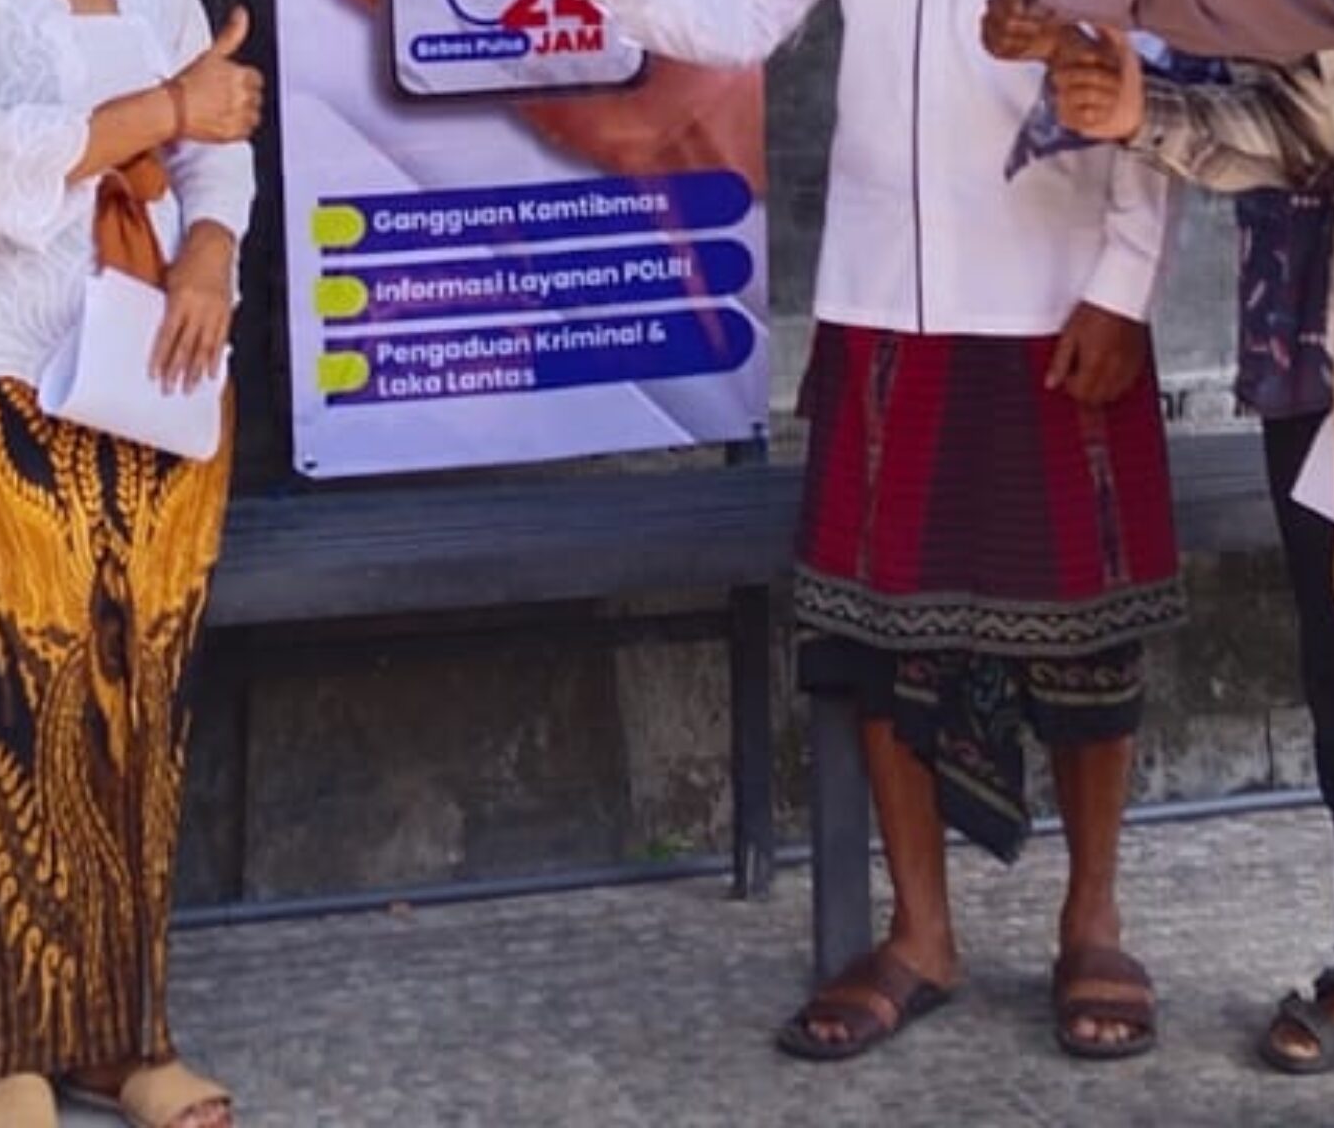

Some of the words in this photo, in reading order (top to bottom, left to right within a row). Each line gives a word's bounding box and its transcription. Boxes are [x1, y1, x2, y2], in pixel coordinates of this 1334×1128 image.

[417, 40, 472, 58] Bebas
[476, 38, 526, 55] Pulsa
[534, 28, 604, 55] JAM
[373, 205, 515, 236] Gangguan
[519, 193, 669, 222] Kamtibmas
[376, 271, 503, 302] Informasi
[508, 267, 619, 297] Layanan
[623, 256, 693, 283] POLRI
[377, 334, 531, 368] Pengaduan
[535, 320, 643, 352] Kriminal
[647, 319, 667, 343] &
[378, 373, 442, 397] Laka
[447, 367, 536, 392] Lantas
